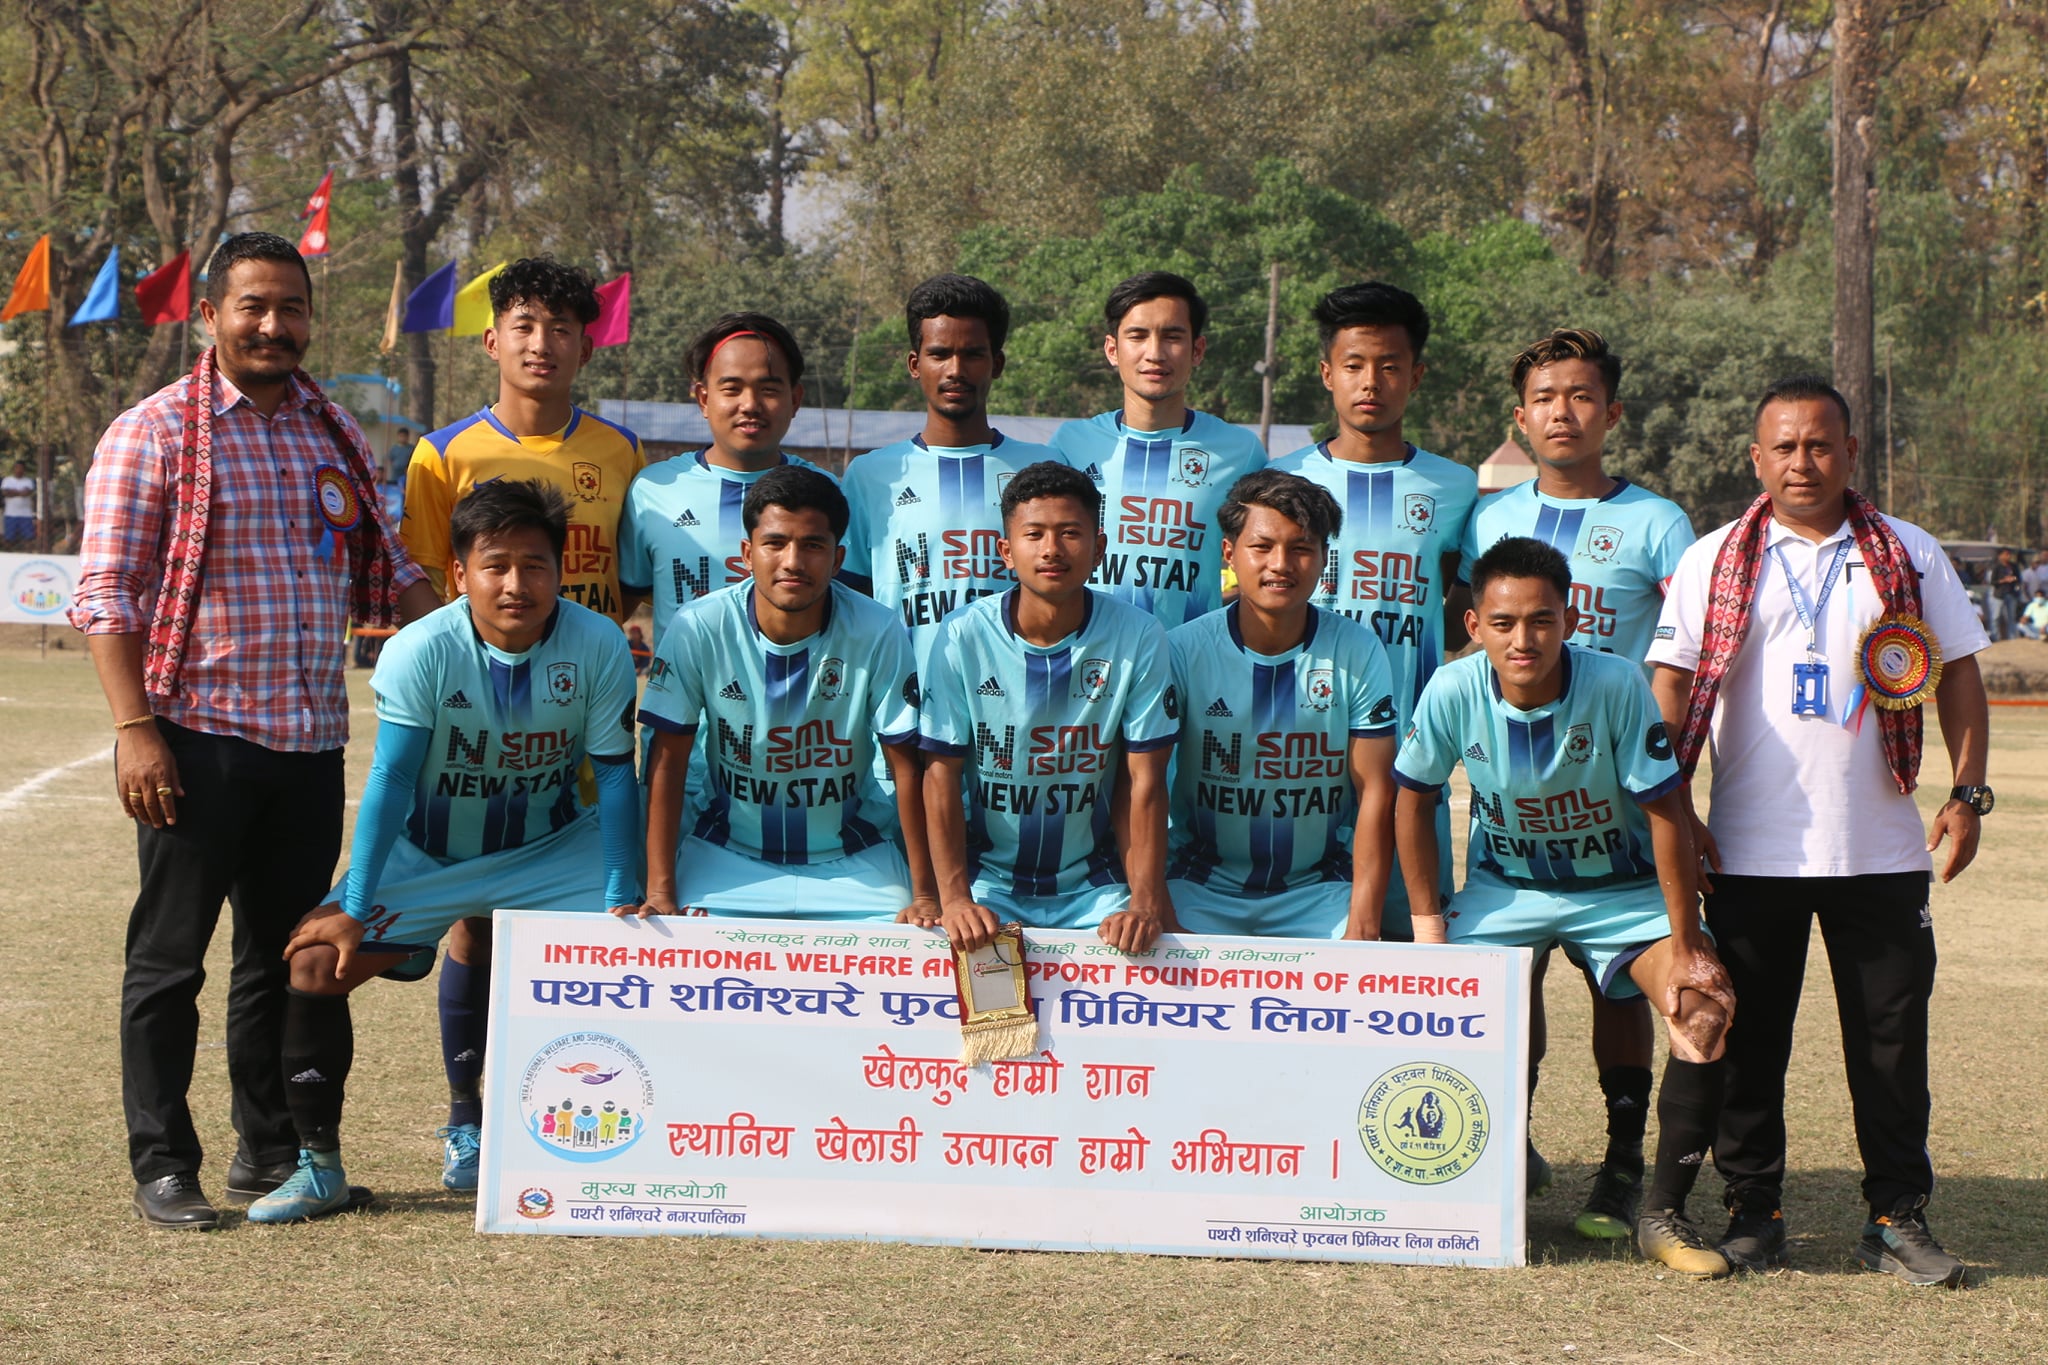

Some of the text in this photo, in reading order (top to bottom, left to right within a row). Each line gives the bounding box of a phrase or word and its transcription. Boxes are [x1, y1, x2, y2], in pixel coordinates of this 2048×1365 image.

[895, 496, 922, 507] adidas
[1120, 496, 1206, 530] SML
[564, 525, 611, 553] ML
[941, 530, 1001, 556] SM
[1118, 524, 1205, 550] ISUZU
[1087, 553, 1201, 592] EW STAR
[1353, 550, 1429, 584] SML
[1351, 579, 1428, 606] ISUZU
[1568, 582, 1617, 615] ML
[442, 701, 472, 709] adidas
[719, 692, 747, 701] adidas
[976, 688, 1006, 697] adidas
[501, 728, 578, 757] SML
[767, 719, 853, 753] SML
[1028, 723, 1113, 754] SML
[1255, 732, 1345, 758] SML
[766, 748, 854, 773] ISUZU
[1254, 759, 1344, 780] ISUZU
[436, 772, 507, 799] NEW
[718, 764, 857, 809] NEW STAR
[976, 780, 1099, 816] NEW STA
[1196, 781, 1344, 818] NEW STAR
[1515, 788, 1609, 818] SML
[1518, 810, 1613, 834] ISUZU
[1548, 828, 1624, 861] STAR
[812, 932, 861, 948] हाम्रो
[1164, 945, 1212, 961] हाम्रो
[544, 944, 777, 973] INTRA-NATIONAL
[785, 952, 913, 978] WELFARE
[922, 957, 956, 979] AN
[1027, 961, 1116, 985] PPORT
[1125, 964, 1303, 991] FOUNDATION
[1314, 971, 1349, 994] OF
[1358, 973, 1479, 998] AMERICA
[531, 974, 654, 1010] पथरी
[669, 976, 864, 1017] शनिश्चरे
[1060, 989, 1235, 1031] प्रिमियर
[1250, 996, 1486, 1039] लिग-२०७८
[572, 1034, 586, 1043] AND
[587, 1033, 616, 1046] SUPPORT
[862, 1044, 1156, 1106] खेलकुद हाम्रो शान
[666, 1112, 796, 1157] स्थानिय
[814, 1116, 924, 1164] खेलाडी
[942, 1131, 1060, 1169] उत्पादन
[1077, 1127, 1152, 1175] हाम्रो
[1170, 1129, 1306, 1177] अभियान
[581, 1179, 728, 1200] मुख्य सहयोगी
[570, 1205, 748, 1225] पथरी शनिश्चरे नगरपालिका
[1299, 1202, 1388, 1223] आयोजक
[1208, 1225, 1481, 1251] पथरी शनिश्चरे फुटबल प्रिमियर लिग कमिटी
